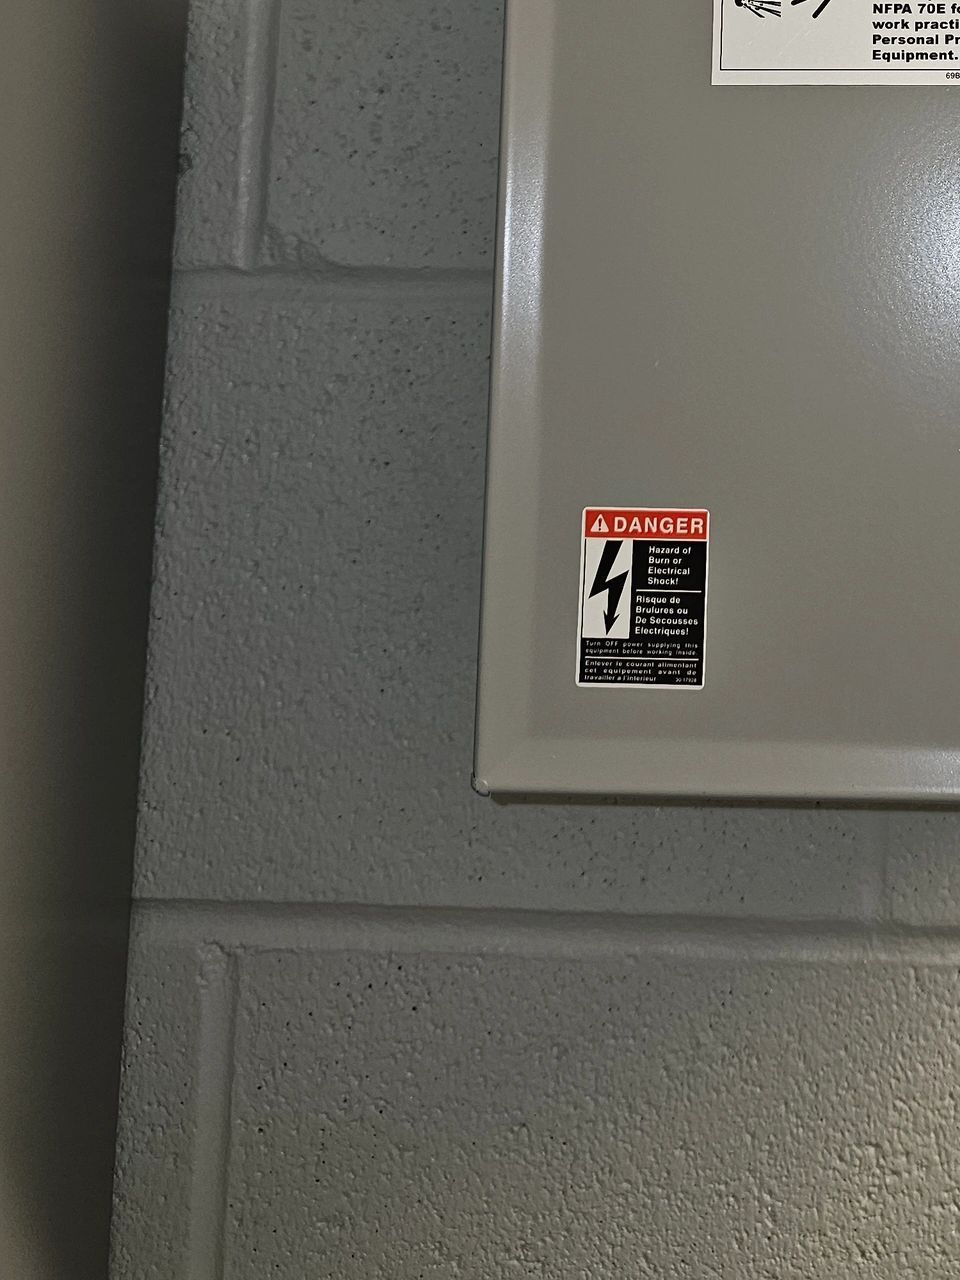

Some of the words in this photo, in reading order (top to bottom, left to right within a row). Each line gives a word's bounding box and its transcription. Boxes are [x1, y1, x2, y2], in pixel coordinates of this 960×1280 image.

[873, 4, 912, 14] NFPA
[917, 3, 946, 14] 70E
[872, 19, 909, 30] work
[873, 34, 939, 45] Personal
[873, 50, 958, 62] Equipment.
[614, 517, 704, 534] DANGER
[649, 546, 679, 554] Hazard
[648, 567, 690, 575] Electrical
[648, 577, 679, 585] Shock!
[636, 596, 667, 604] Risque
[636, 606, 674, 614] Brulures
[650, 617, 698, 625] Secousses
[635, 627, 689, 636] Electriques!
